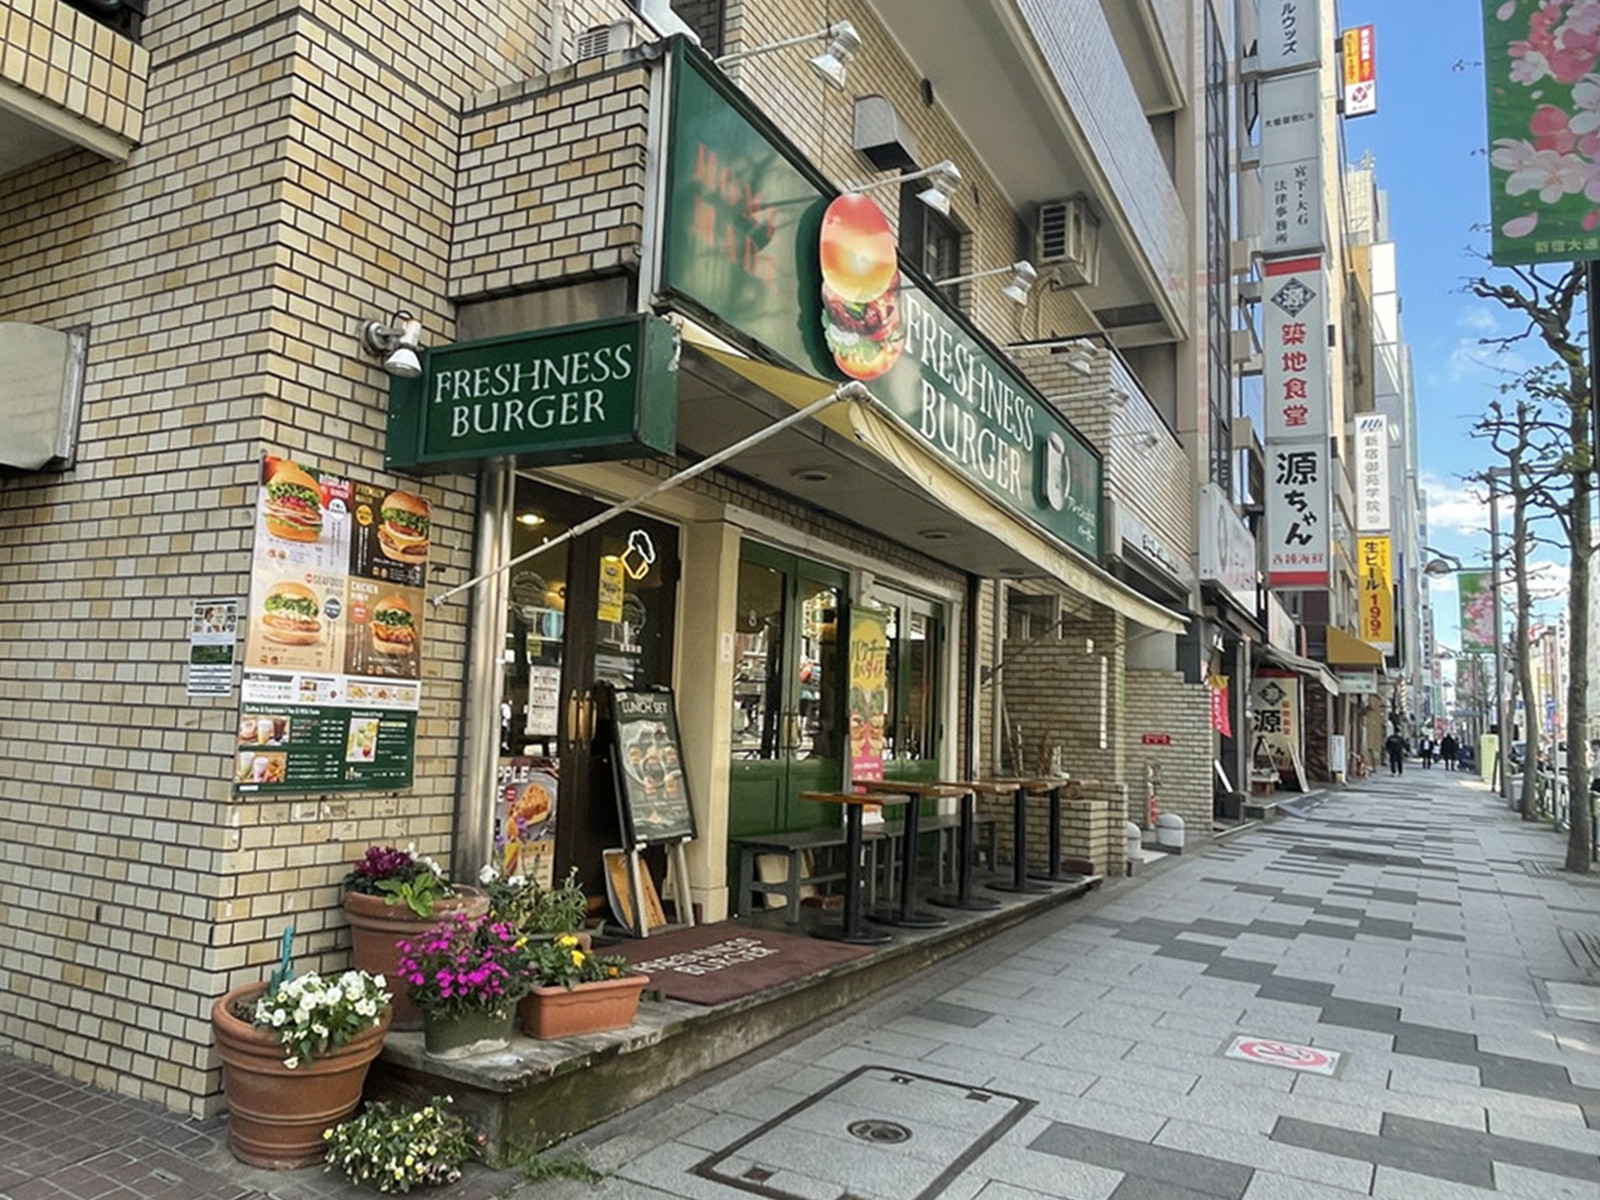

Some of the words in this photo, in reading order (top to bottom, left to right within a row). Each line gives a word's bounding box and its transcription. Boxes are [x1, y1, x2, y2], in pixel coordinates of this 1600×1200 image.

[435, 344, 632, 403] FRESHNESS
[451, 389, 606, 438] BURGER
[904, 293, 1034, 451] FRESHNESS
[1281, 322, 1308, 427] 築地食堂
[920, 378, 1023, 500] BURGER
[1276, 451, 1317, 546] 源ちゃん
